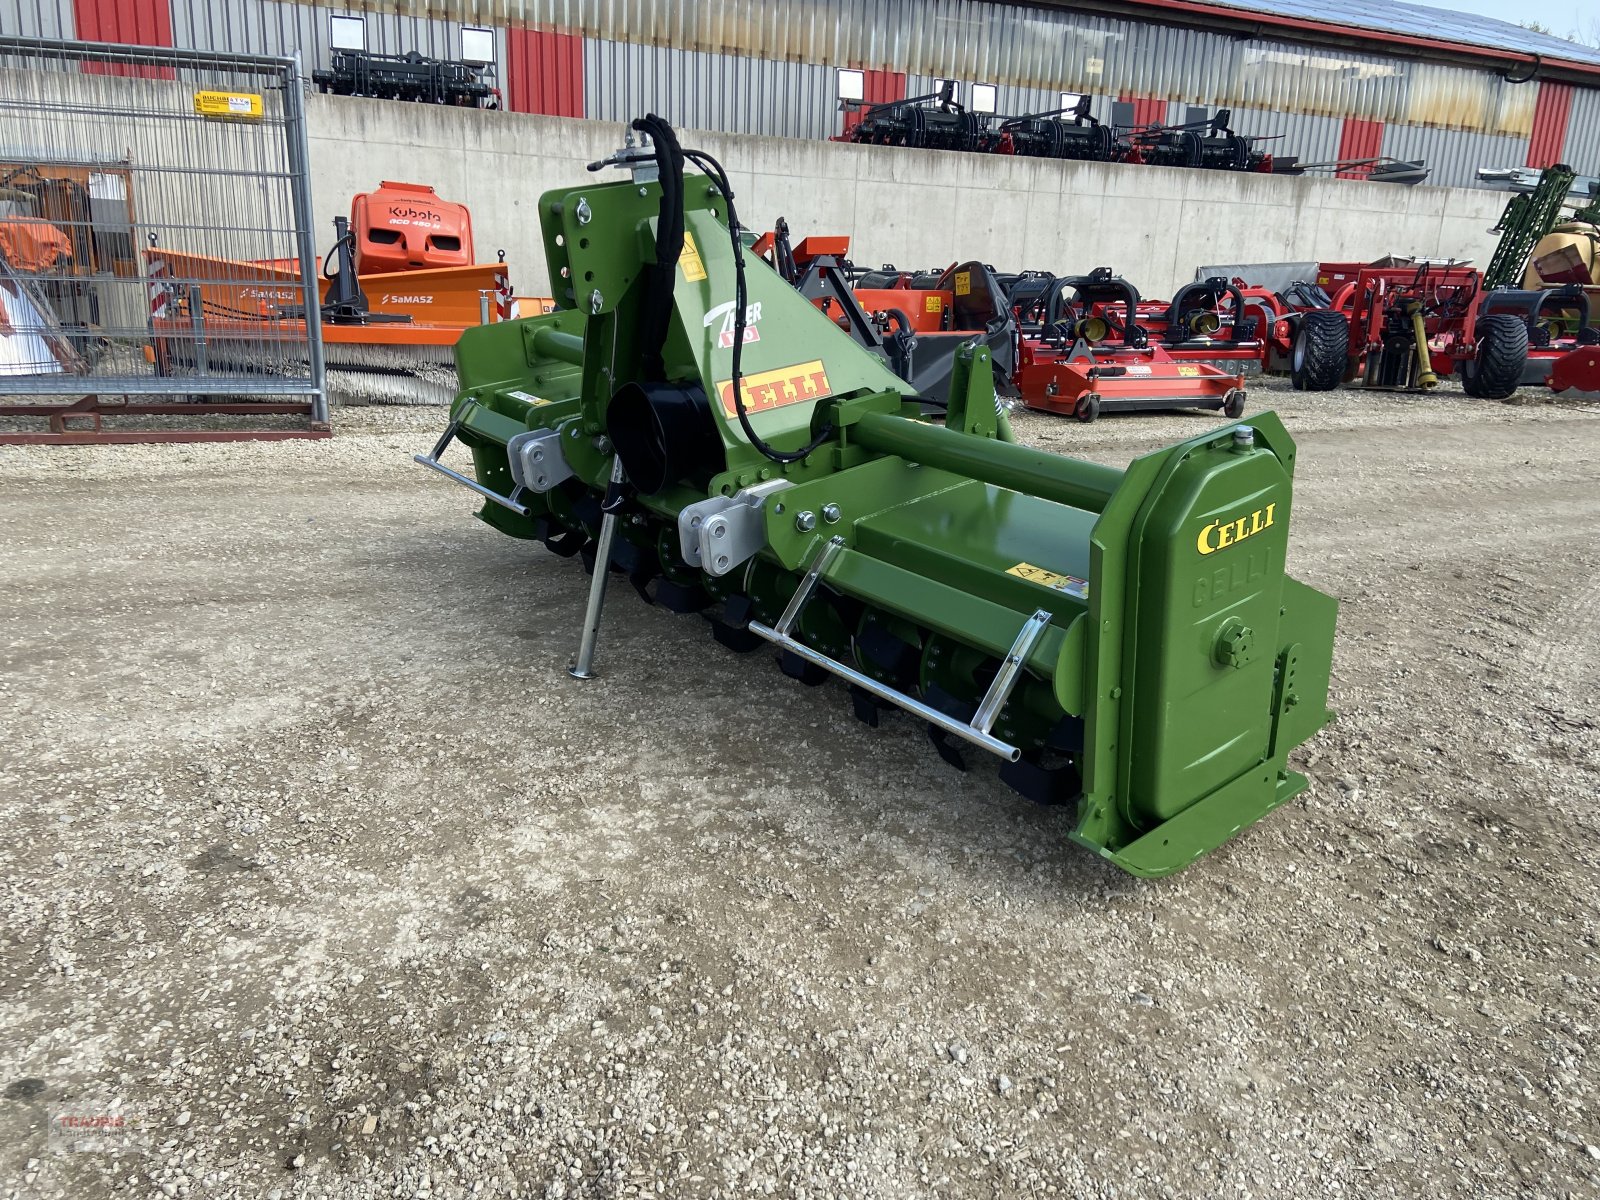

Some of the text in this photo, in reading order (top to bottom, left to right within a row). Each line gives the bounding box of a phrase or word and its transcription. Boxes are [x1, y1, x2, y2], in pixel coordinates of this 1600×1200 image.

[389, 207, 441, 221] Kubota
[391, 295, 433, 304] SaMASZ
[704, 300, 762, 348] TIER
[726, 329, 754, 344] 10
[722, 371, 830, 415] CELLI
[1196, 502, 1276, 555] CELLI
[1192, 546, 1272, 608] CELLI
